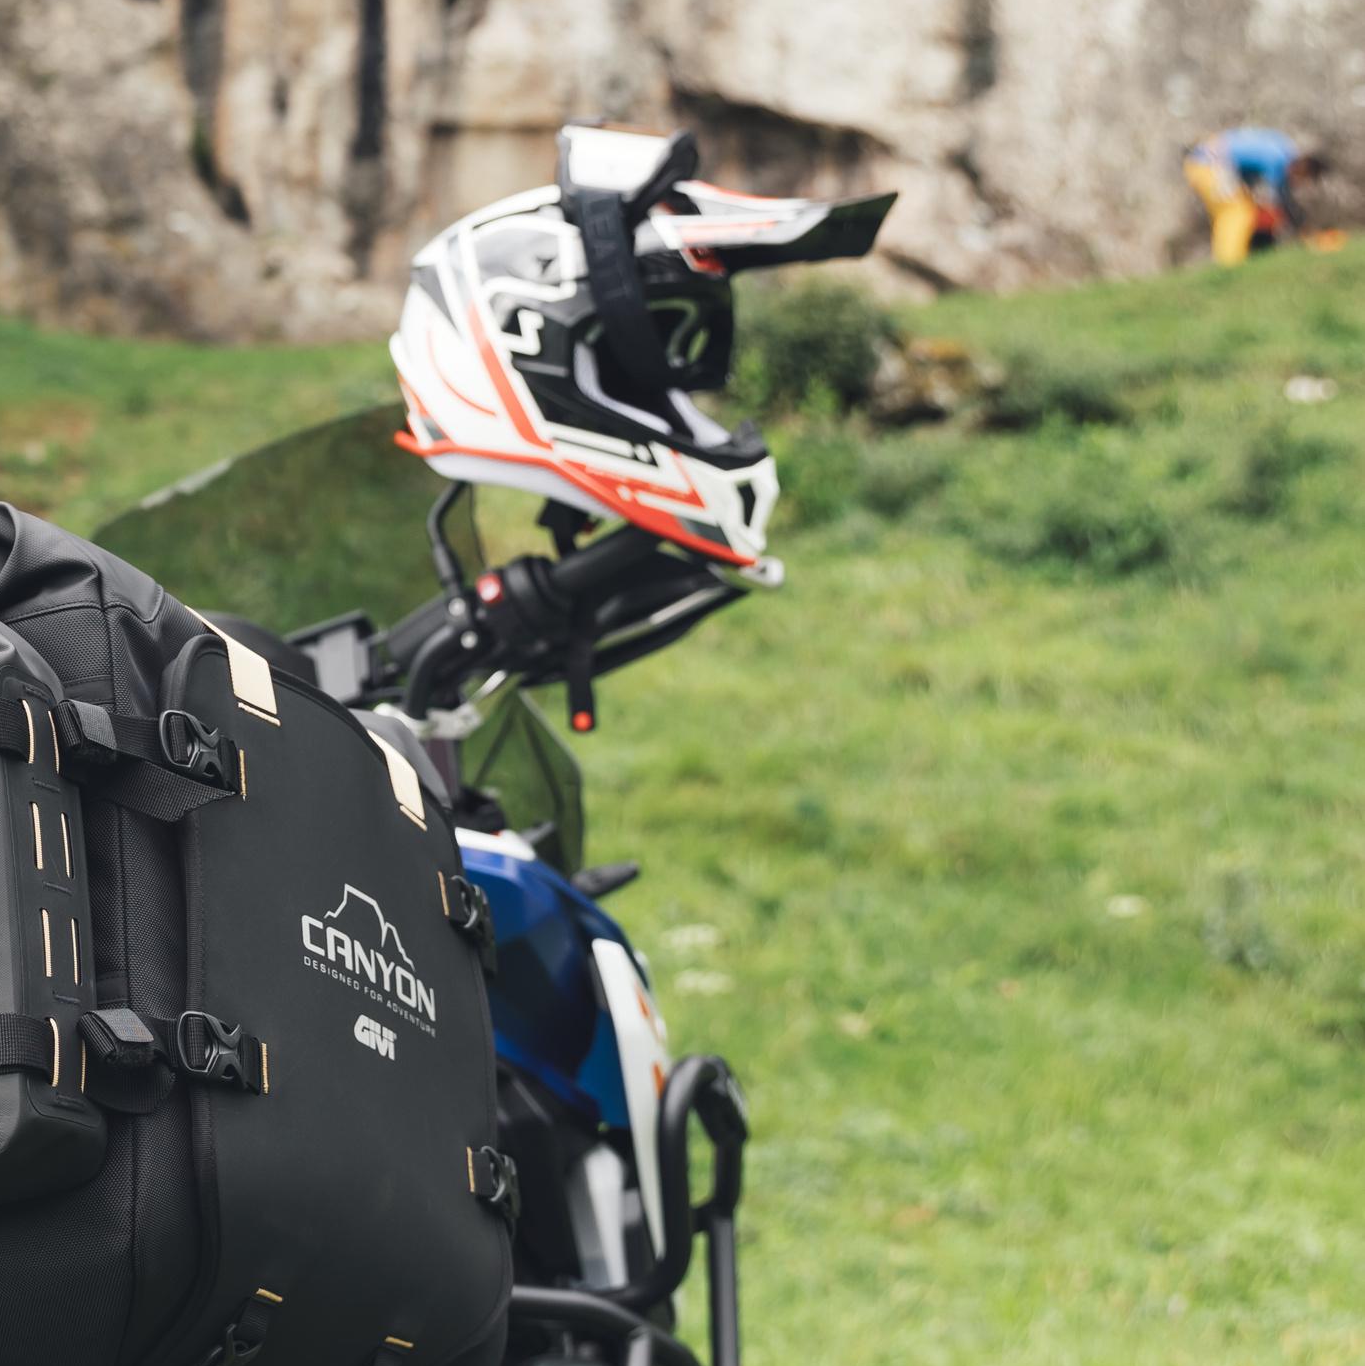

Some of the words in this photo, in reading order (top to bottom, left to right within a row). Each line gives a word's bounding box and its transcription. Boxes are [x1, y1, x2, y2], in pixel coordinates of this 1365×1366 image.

[301, 915, 436, 1022] CANYON
[303, 955, 360, 991] DESIGNED
[364, 986, 384, 1003] FOR
[386, 1000, 437, 1038] ADVENTURE
[353, 1014, 398, 1061] GIVI
